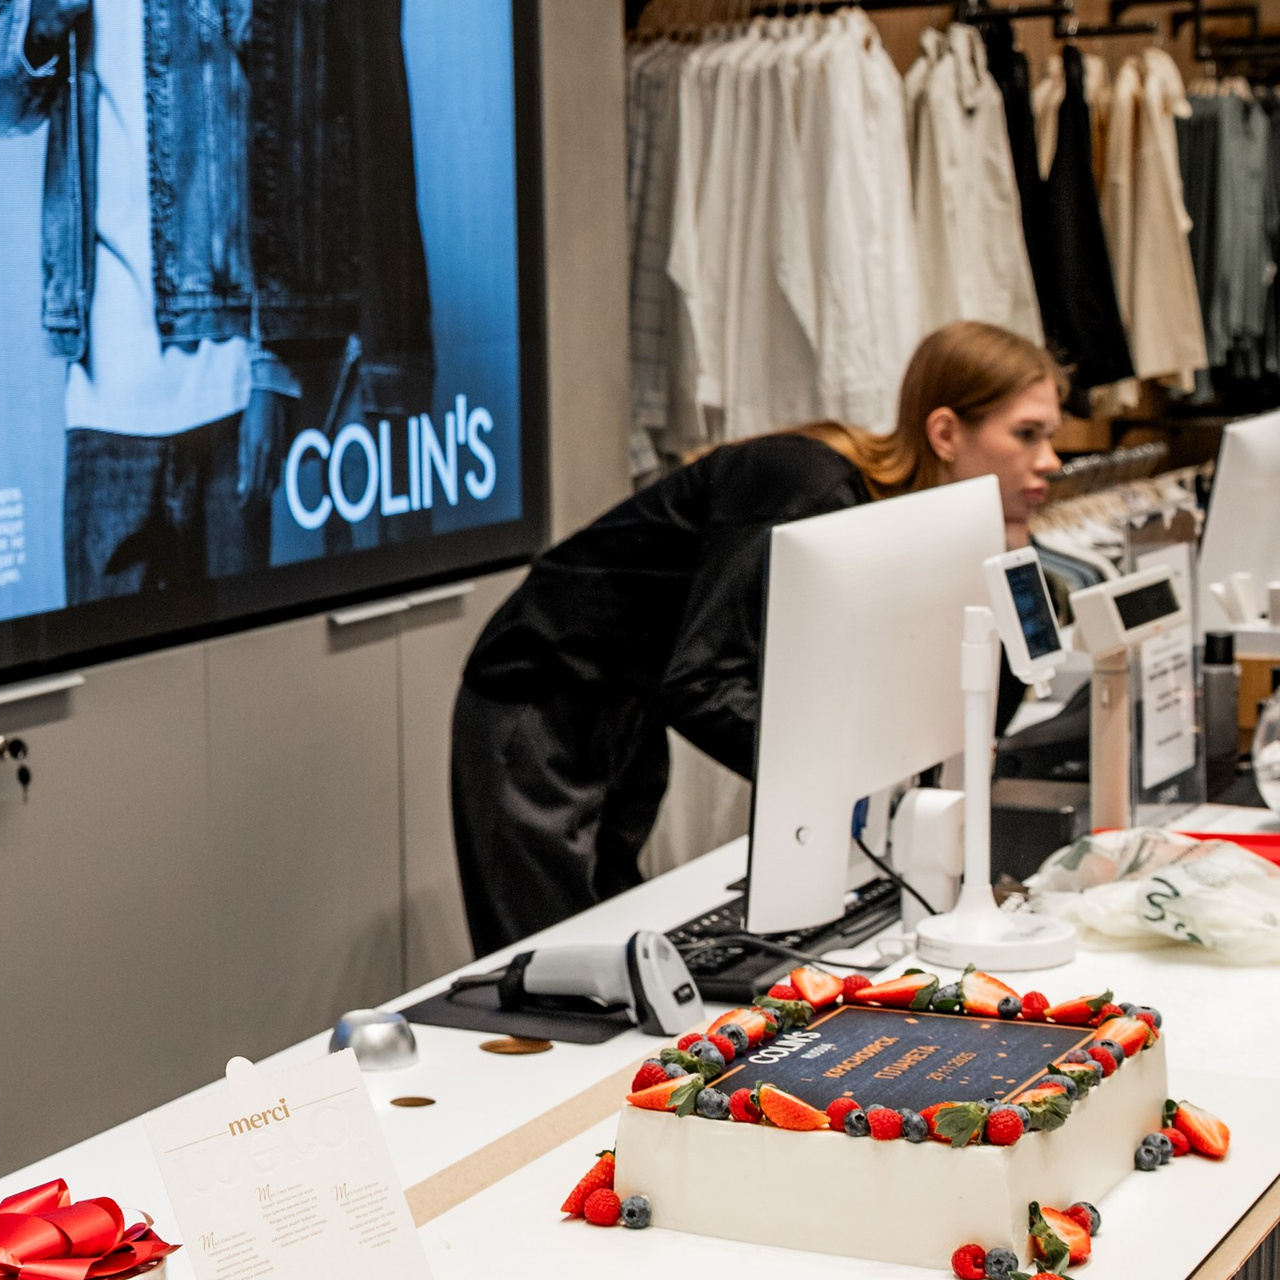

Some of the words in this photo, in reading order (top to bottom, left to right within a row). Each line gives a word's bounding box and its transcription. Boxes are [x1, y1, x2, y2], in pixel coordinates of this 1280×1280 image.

[285, 393, 497, 531] COLIN'S
[873, 1045, 941, 1080] ПЛАНЕТА
[228, 1097, 291, 1137] merci
